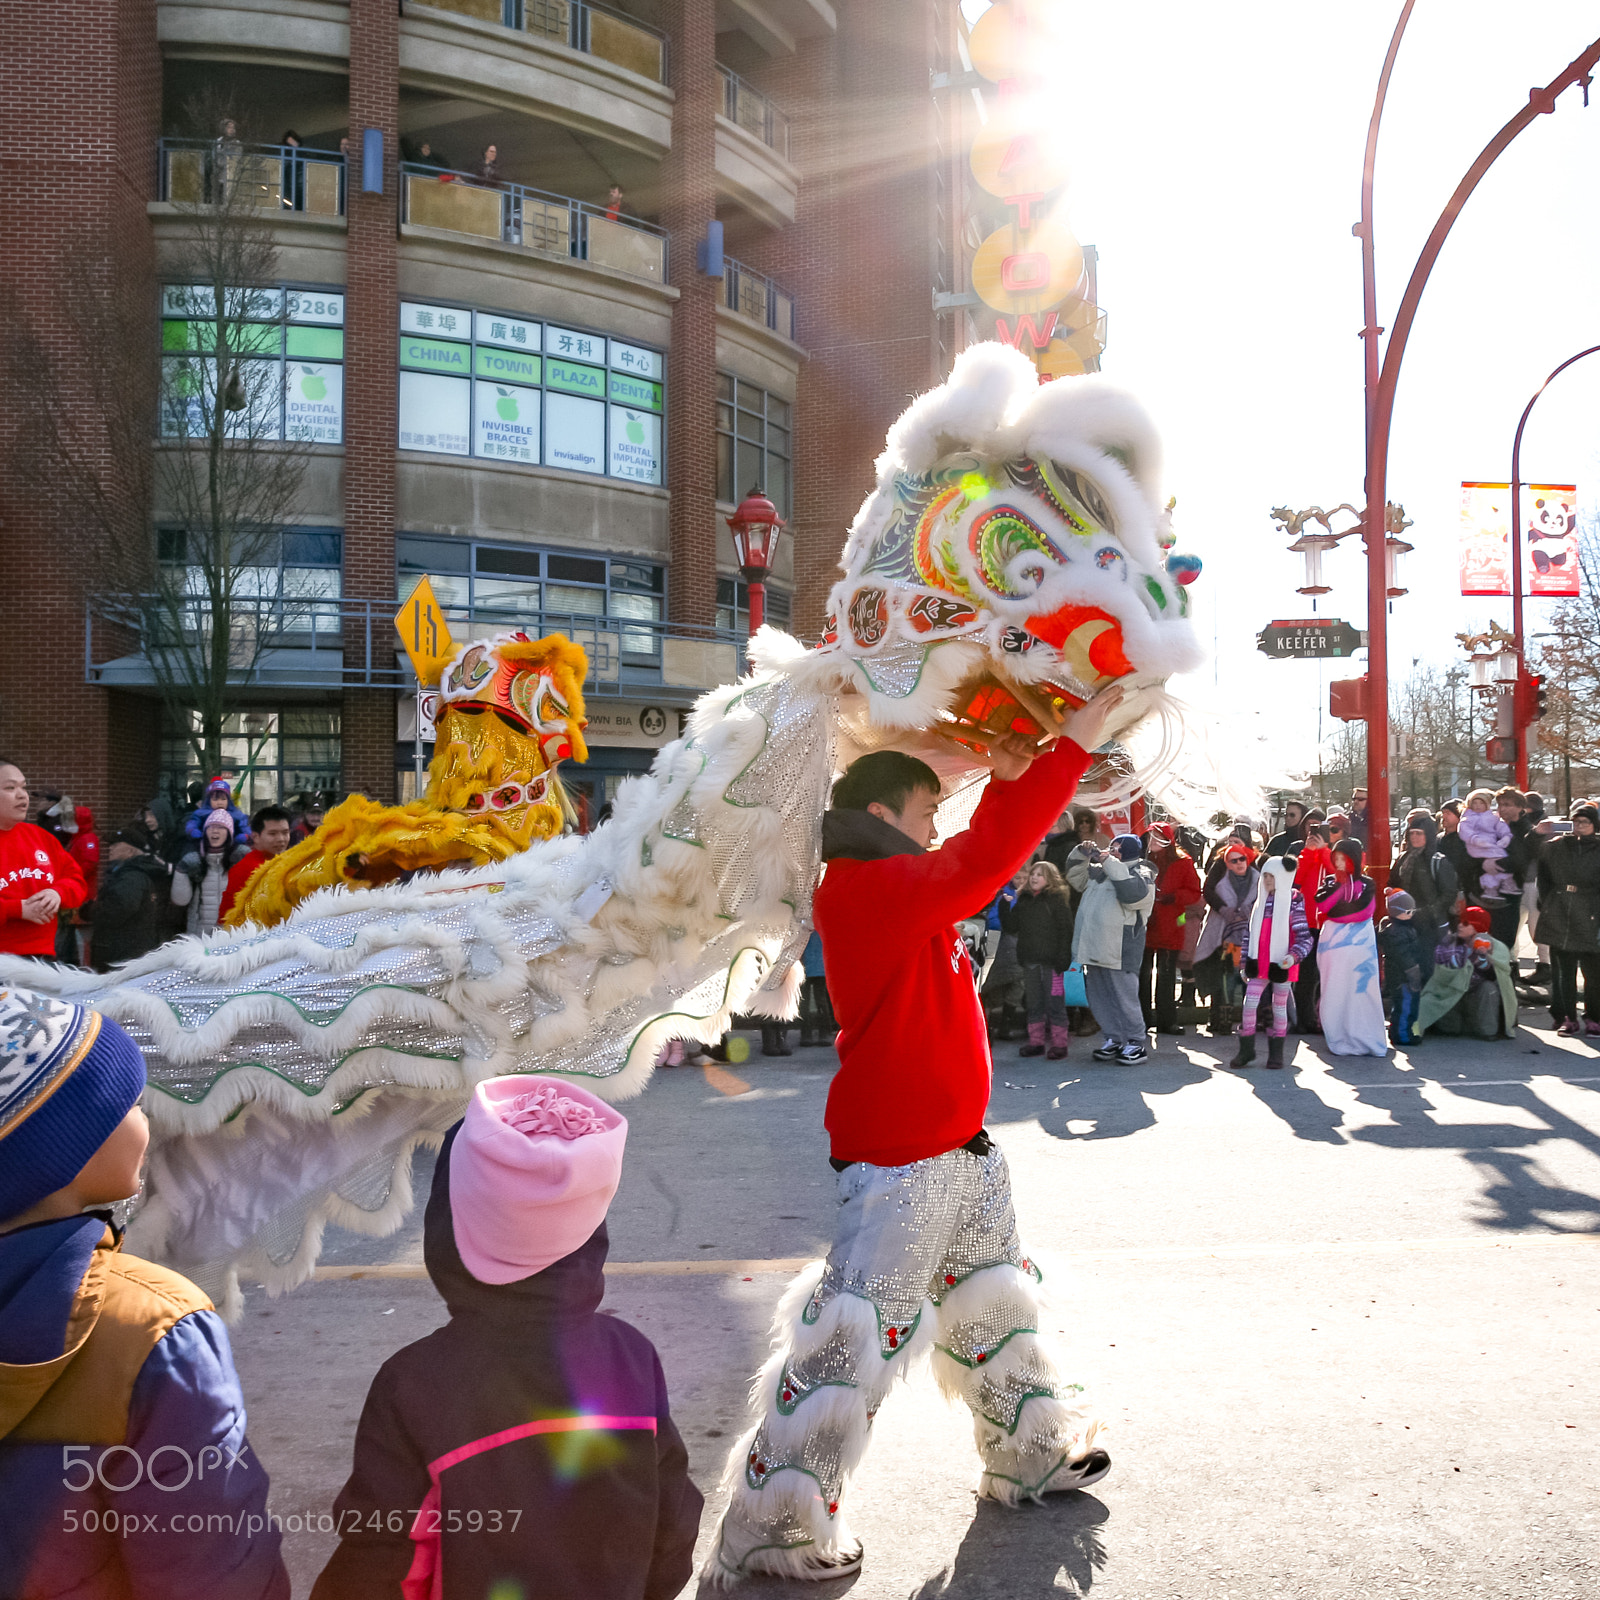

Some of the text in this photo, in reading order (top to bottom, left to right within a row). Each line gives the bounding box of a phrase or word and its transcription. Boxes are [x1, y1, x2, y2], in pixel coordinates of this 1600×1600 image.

[415, 310, 651, 372] 華埠 廣場 牙科 中心
[408, 345, 660, 404] CHINA TOWN PLAZA DENTAL
[290, 402, 336, 414] DENTAL
[287, 413, 340, 426] HYGIENE
[481, 420, 533, 436] INVISIBLE
[487, 432, 528, 446] BRACES
[553, 448, 596, 465] invisalign
[618, 442, 652, 458] DENTAL
[613, 452, 657, 469] IMPLANTS
[1277, 636, 1327, 650] KEEFER
[585, 714, 633, 726] OWN BIA
